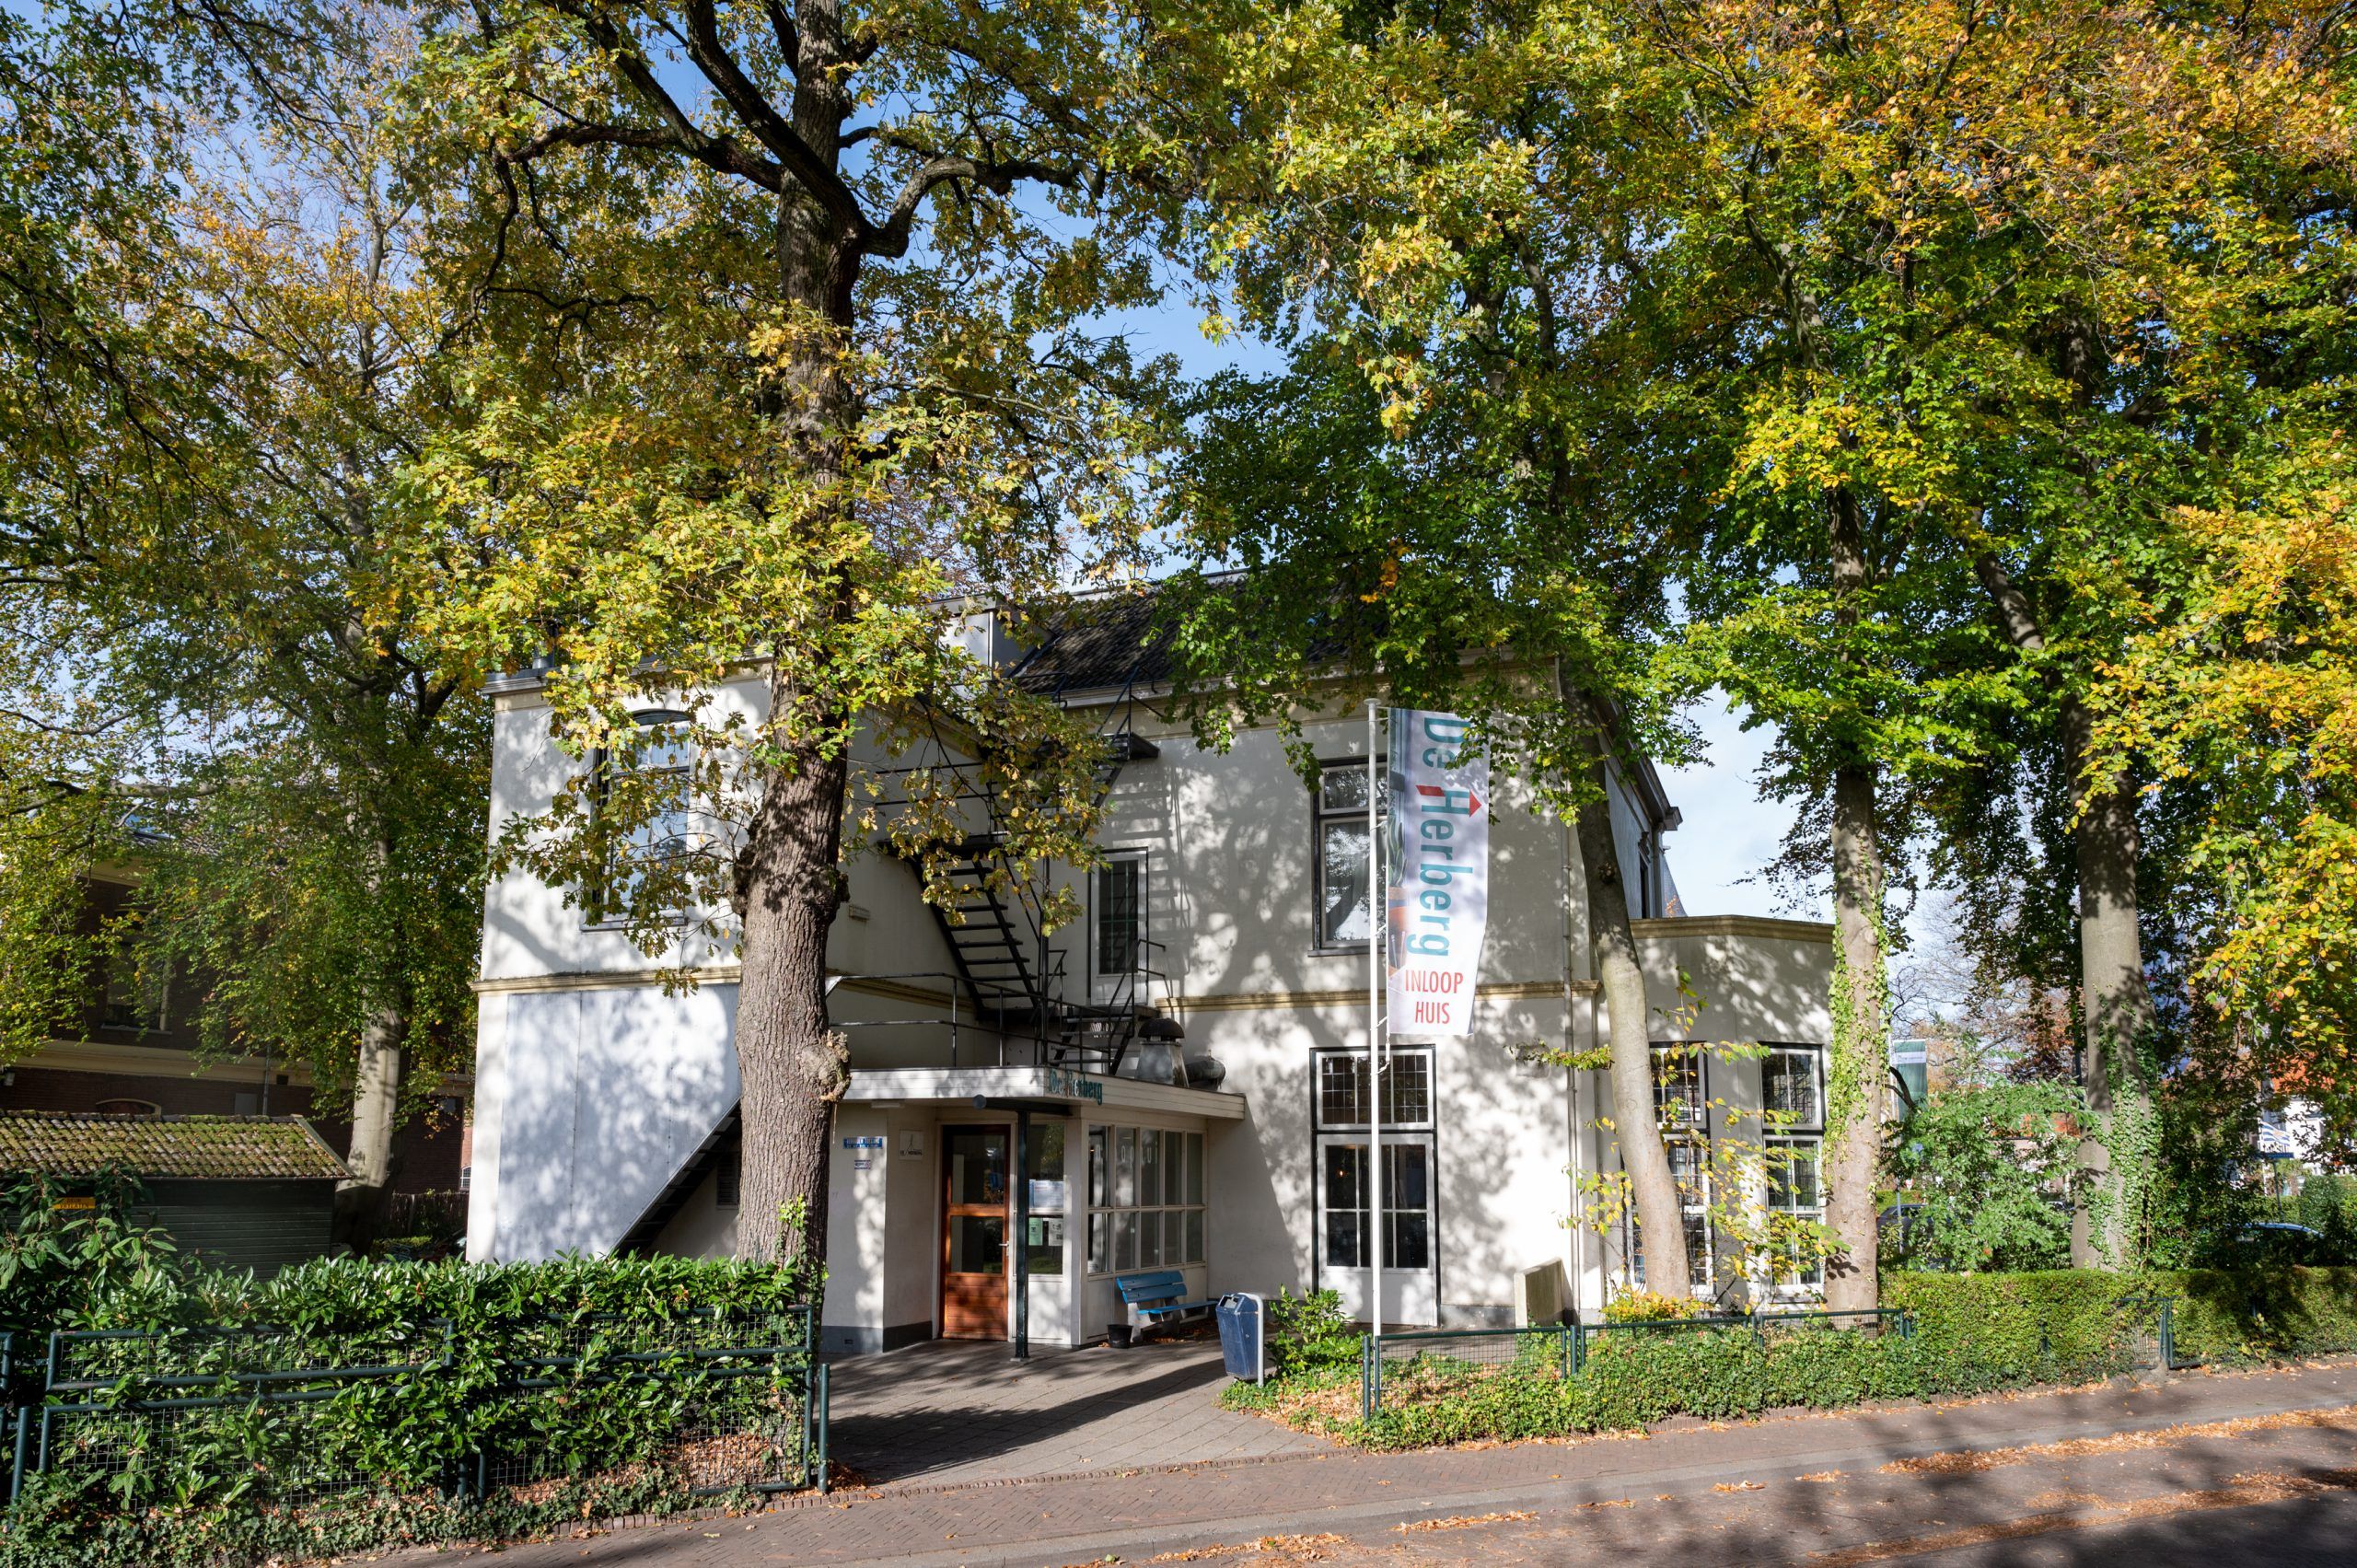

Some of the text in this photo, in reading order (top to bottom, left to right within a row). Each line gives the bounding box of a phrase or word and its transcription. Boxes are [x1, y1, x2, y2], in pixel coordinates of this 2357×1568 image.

[1406, 717, 1475, 956] De Herberg
[1405, 970, 1464, 993] INLOOP
[1415, 1001, 1450, 1024] HUIS
